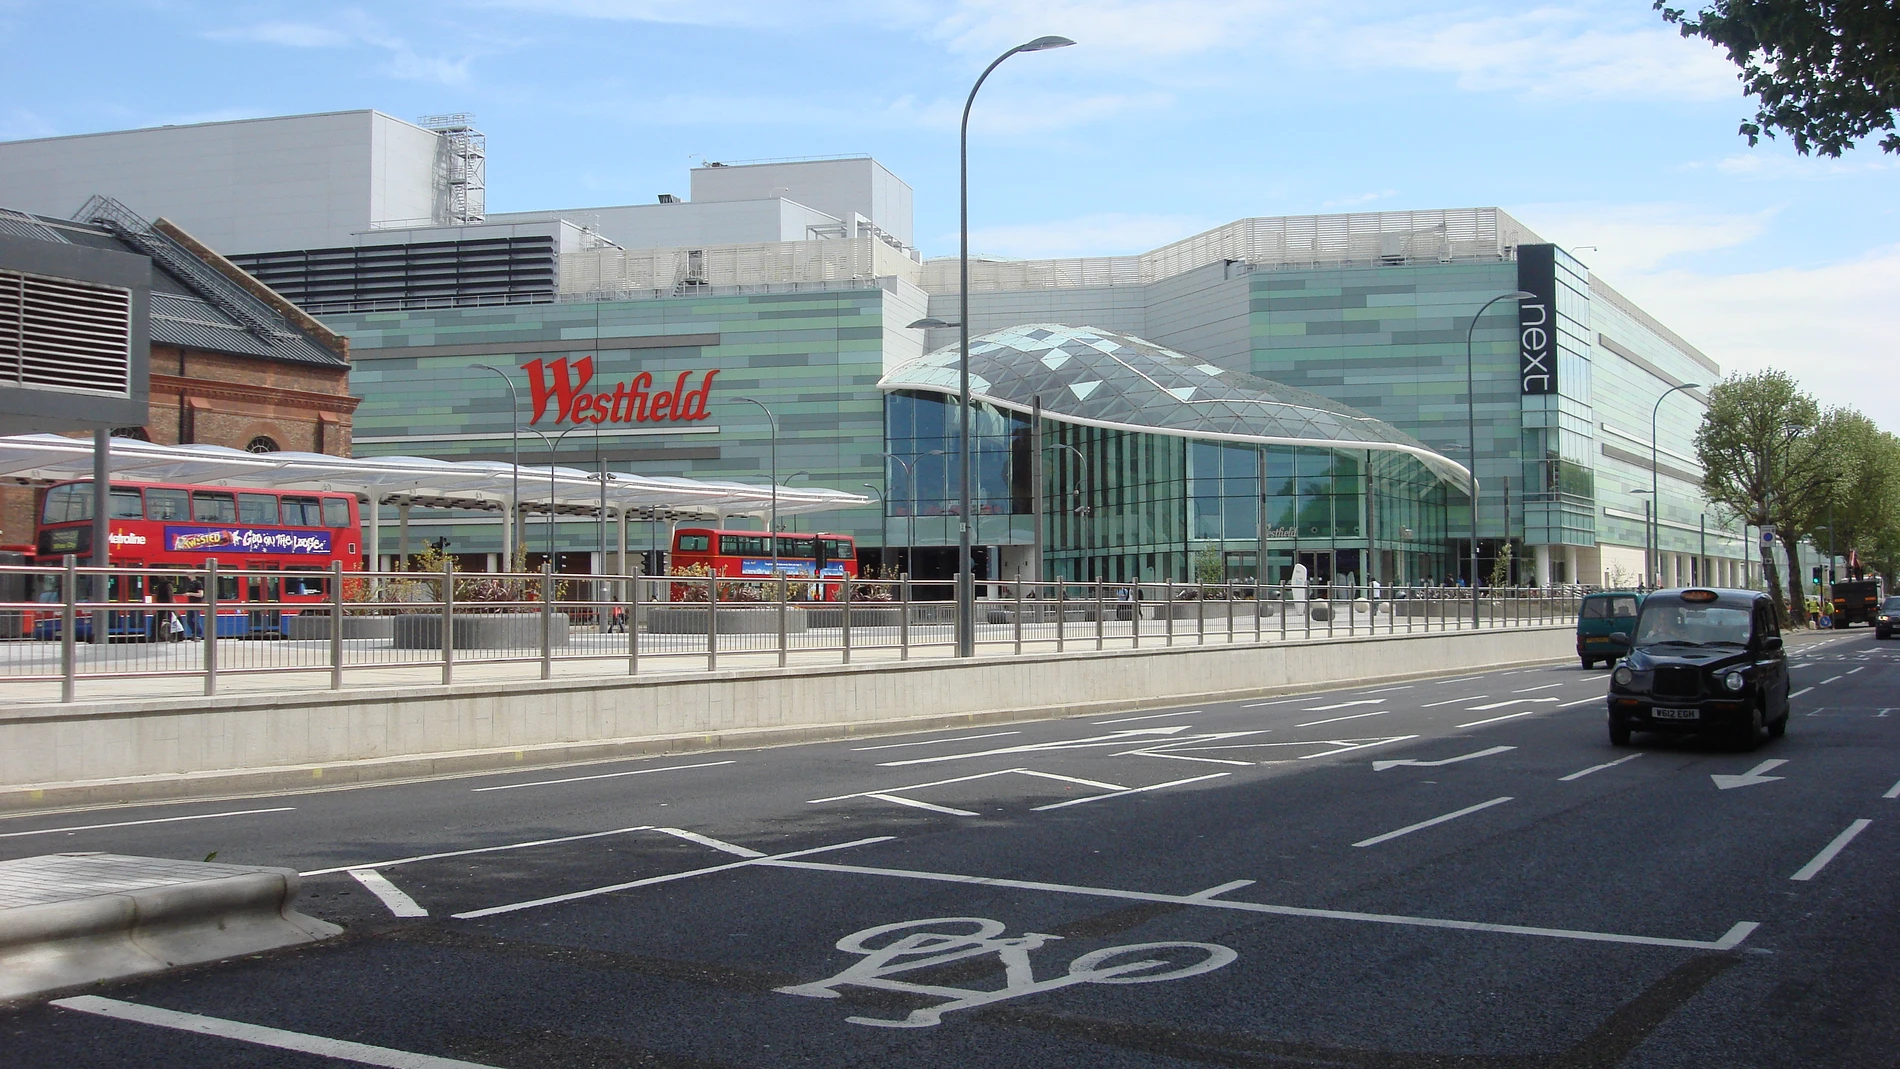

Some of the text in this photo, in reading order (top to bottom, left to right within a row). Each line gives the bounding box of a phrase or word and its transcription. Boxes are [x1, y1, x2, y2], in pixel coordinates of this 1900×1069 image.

[1521, 304, 1550, 392] next
[520, 355, 721, 426] Westfield
[1677, 709, 1695, 718] EGH
